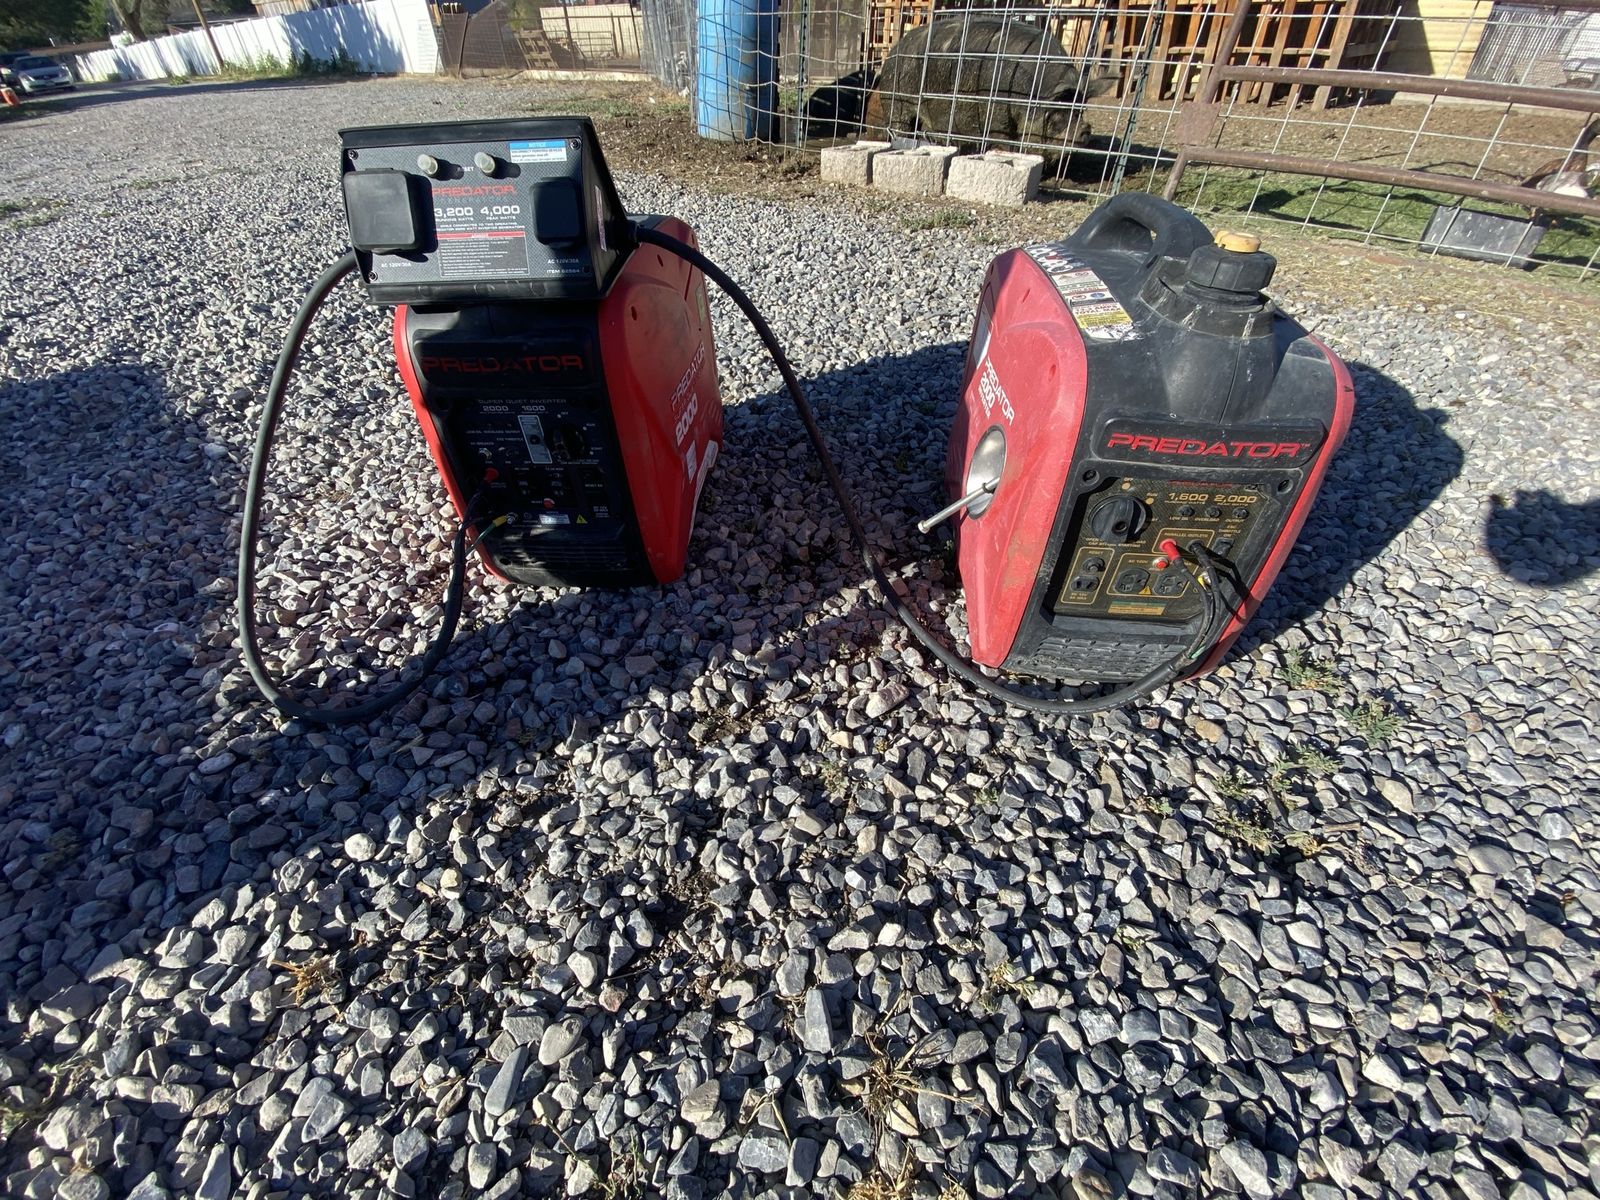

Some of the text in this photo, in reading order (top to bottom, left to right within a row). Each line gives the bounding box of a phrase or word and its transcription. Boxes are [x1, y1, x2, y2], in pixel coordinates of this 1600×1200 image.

[432, 184, 517, 196] PREDATOR
[434, 204, 521, 218] 3,200 4,000
[421, 353, 586, 374] PREDATOR
[670, 340, 705, 412] PREDATOR
[980, 371, 996, 409] 2000
[984, 355, 1016, 427] PREDATOR
[521, 404, 546, 412] 1600
[675, 392, 698, 447] 2000
[1107, 432, 1300, 459] PREDATOR
[1168, 492, 1258, 504] 1,600 2,000
